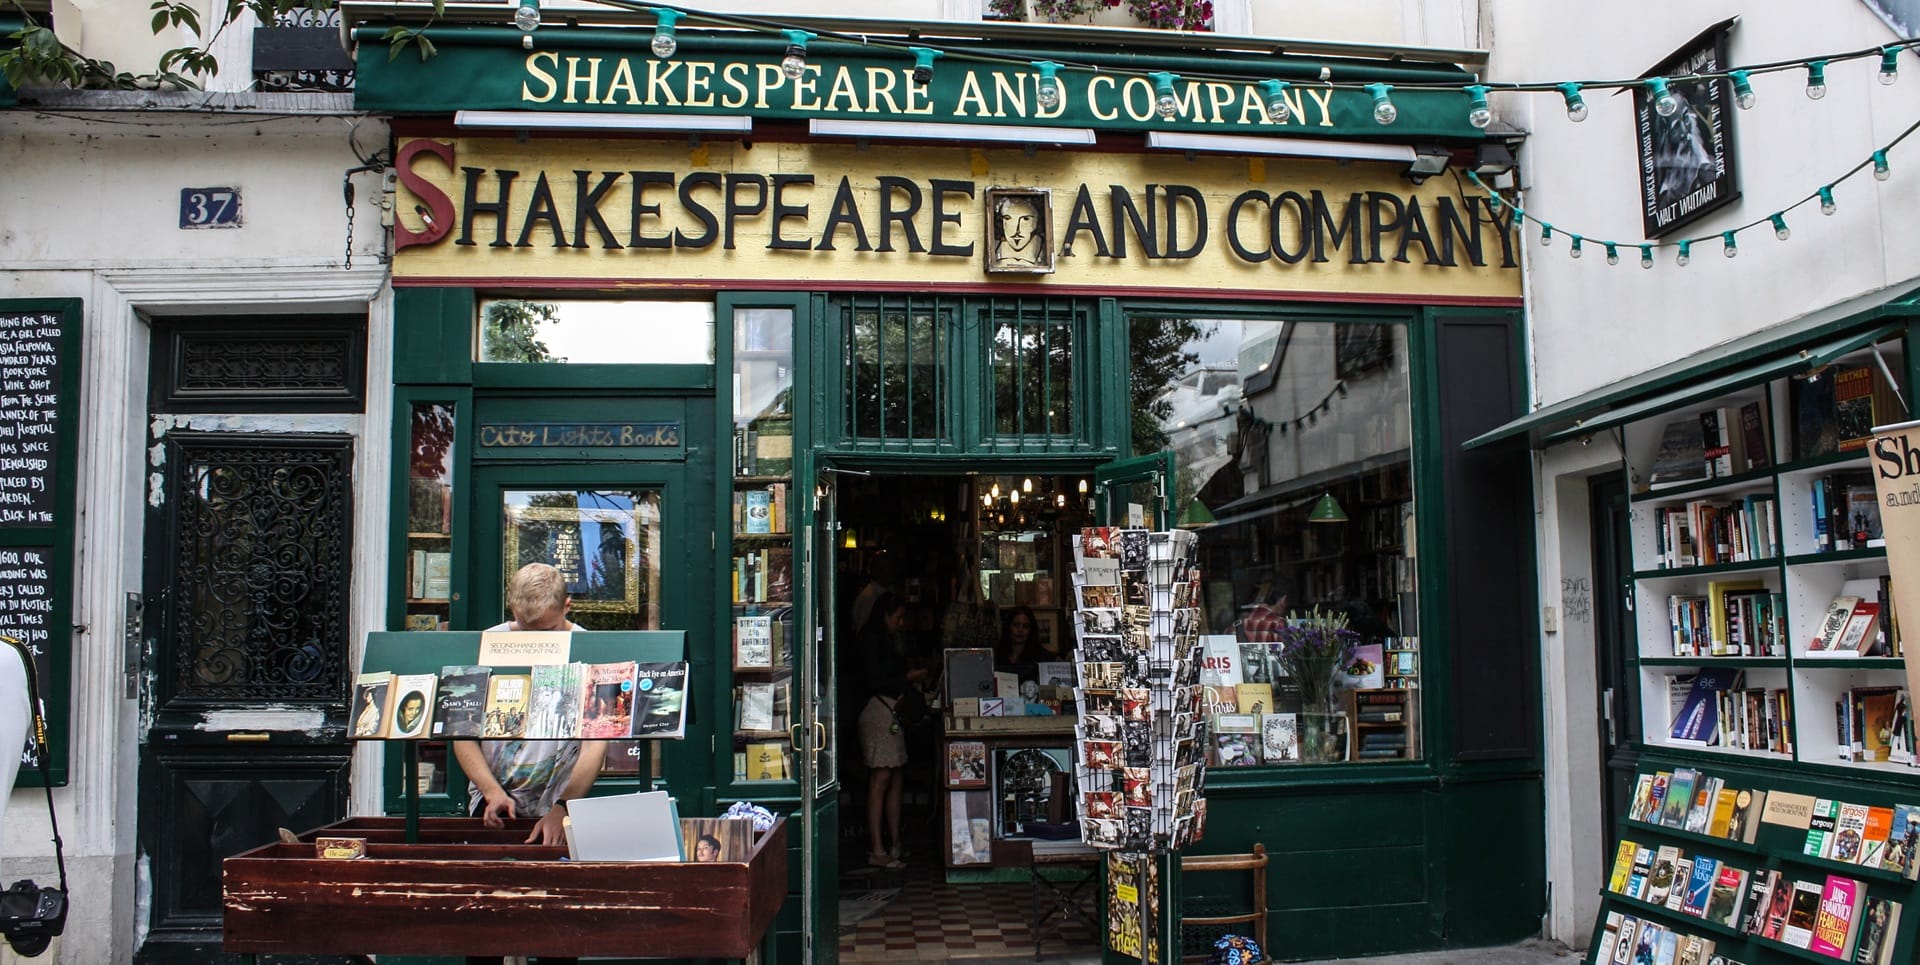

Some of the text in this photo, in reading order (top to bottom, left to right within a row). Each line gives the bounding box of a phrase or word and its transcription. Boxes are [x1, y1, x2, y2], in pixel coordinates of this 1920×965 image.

[522, 52, 1335, 127] SHAKESPEARE AND COMPANY
[188, 192, 233, 224] 37
[395, 138, 1519, 268] SHAKESPEARE AND COMPANY
[1655, 181, 1717, 228] WALT WHITMAN
[22, 316, 39, 327] FOR
[40, 314, 58, 325] THE
[10, 330, 17, 339] A
[18, 329, 35, 339] GIRL
[36, 327, 61, 338] CALLED
[31, 354, 57, 366] YEARS
[3, 366, 48, 379] BOOKSTORE
[4, 379, 51, 391] WINE SHOP
[1, 393, 57, 408] FROM THE SEINE
[0, 409, 57, 422] ANNEX OF THE
[17, 421, 56, 440] HOSPITAL
[480, 425, 537, 446] City
[543, 425, 614, 446] Lights
[0, 441, 50, 454] HAS SINCE
[0, 457, 48, 471] DEMOLISHED
[31, 476, 45, 492] BY
[2, 509, 54, 522] BACK IN THE
[24, 551, 44, 565] OUR
[29, 568, 48, 580] WAS
[18, 584, 45, 596] CALLED
[8, 600, 19, 612] DU
[17, 613, 43, 625] TIMES
[32, 629, 48, 640] HAD
[1841, 807, 1867, 820] argosy
[1811, 819, 1835, 829] argosy
[1830, 886, 1848, 904] JANET
[1821, 899, 1851, 922] EVANOVICH
[1818, 911, 1848, 932] FEARLESS
[1816, 926, 1846, 949] FOURTEEN
